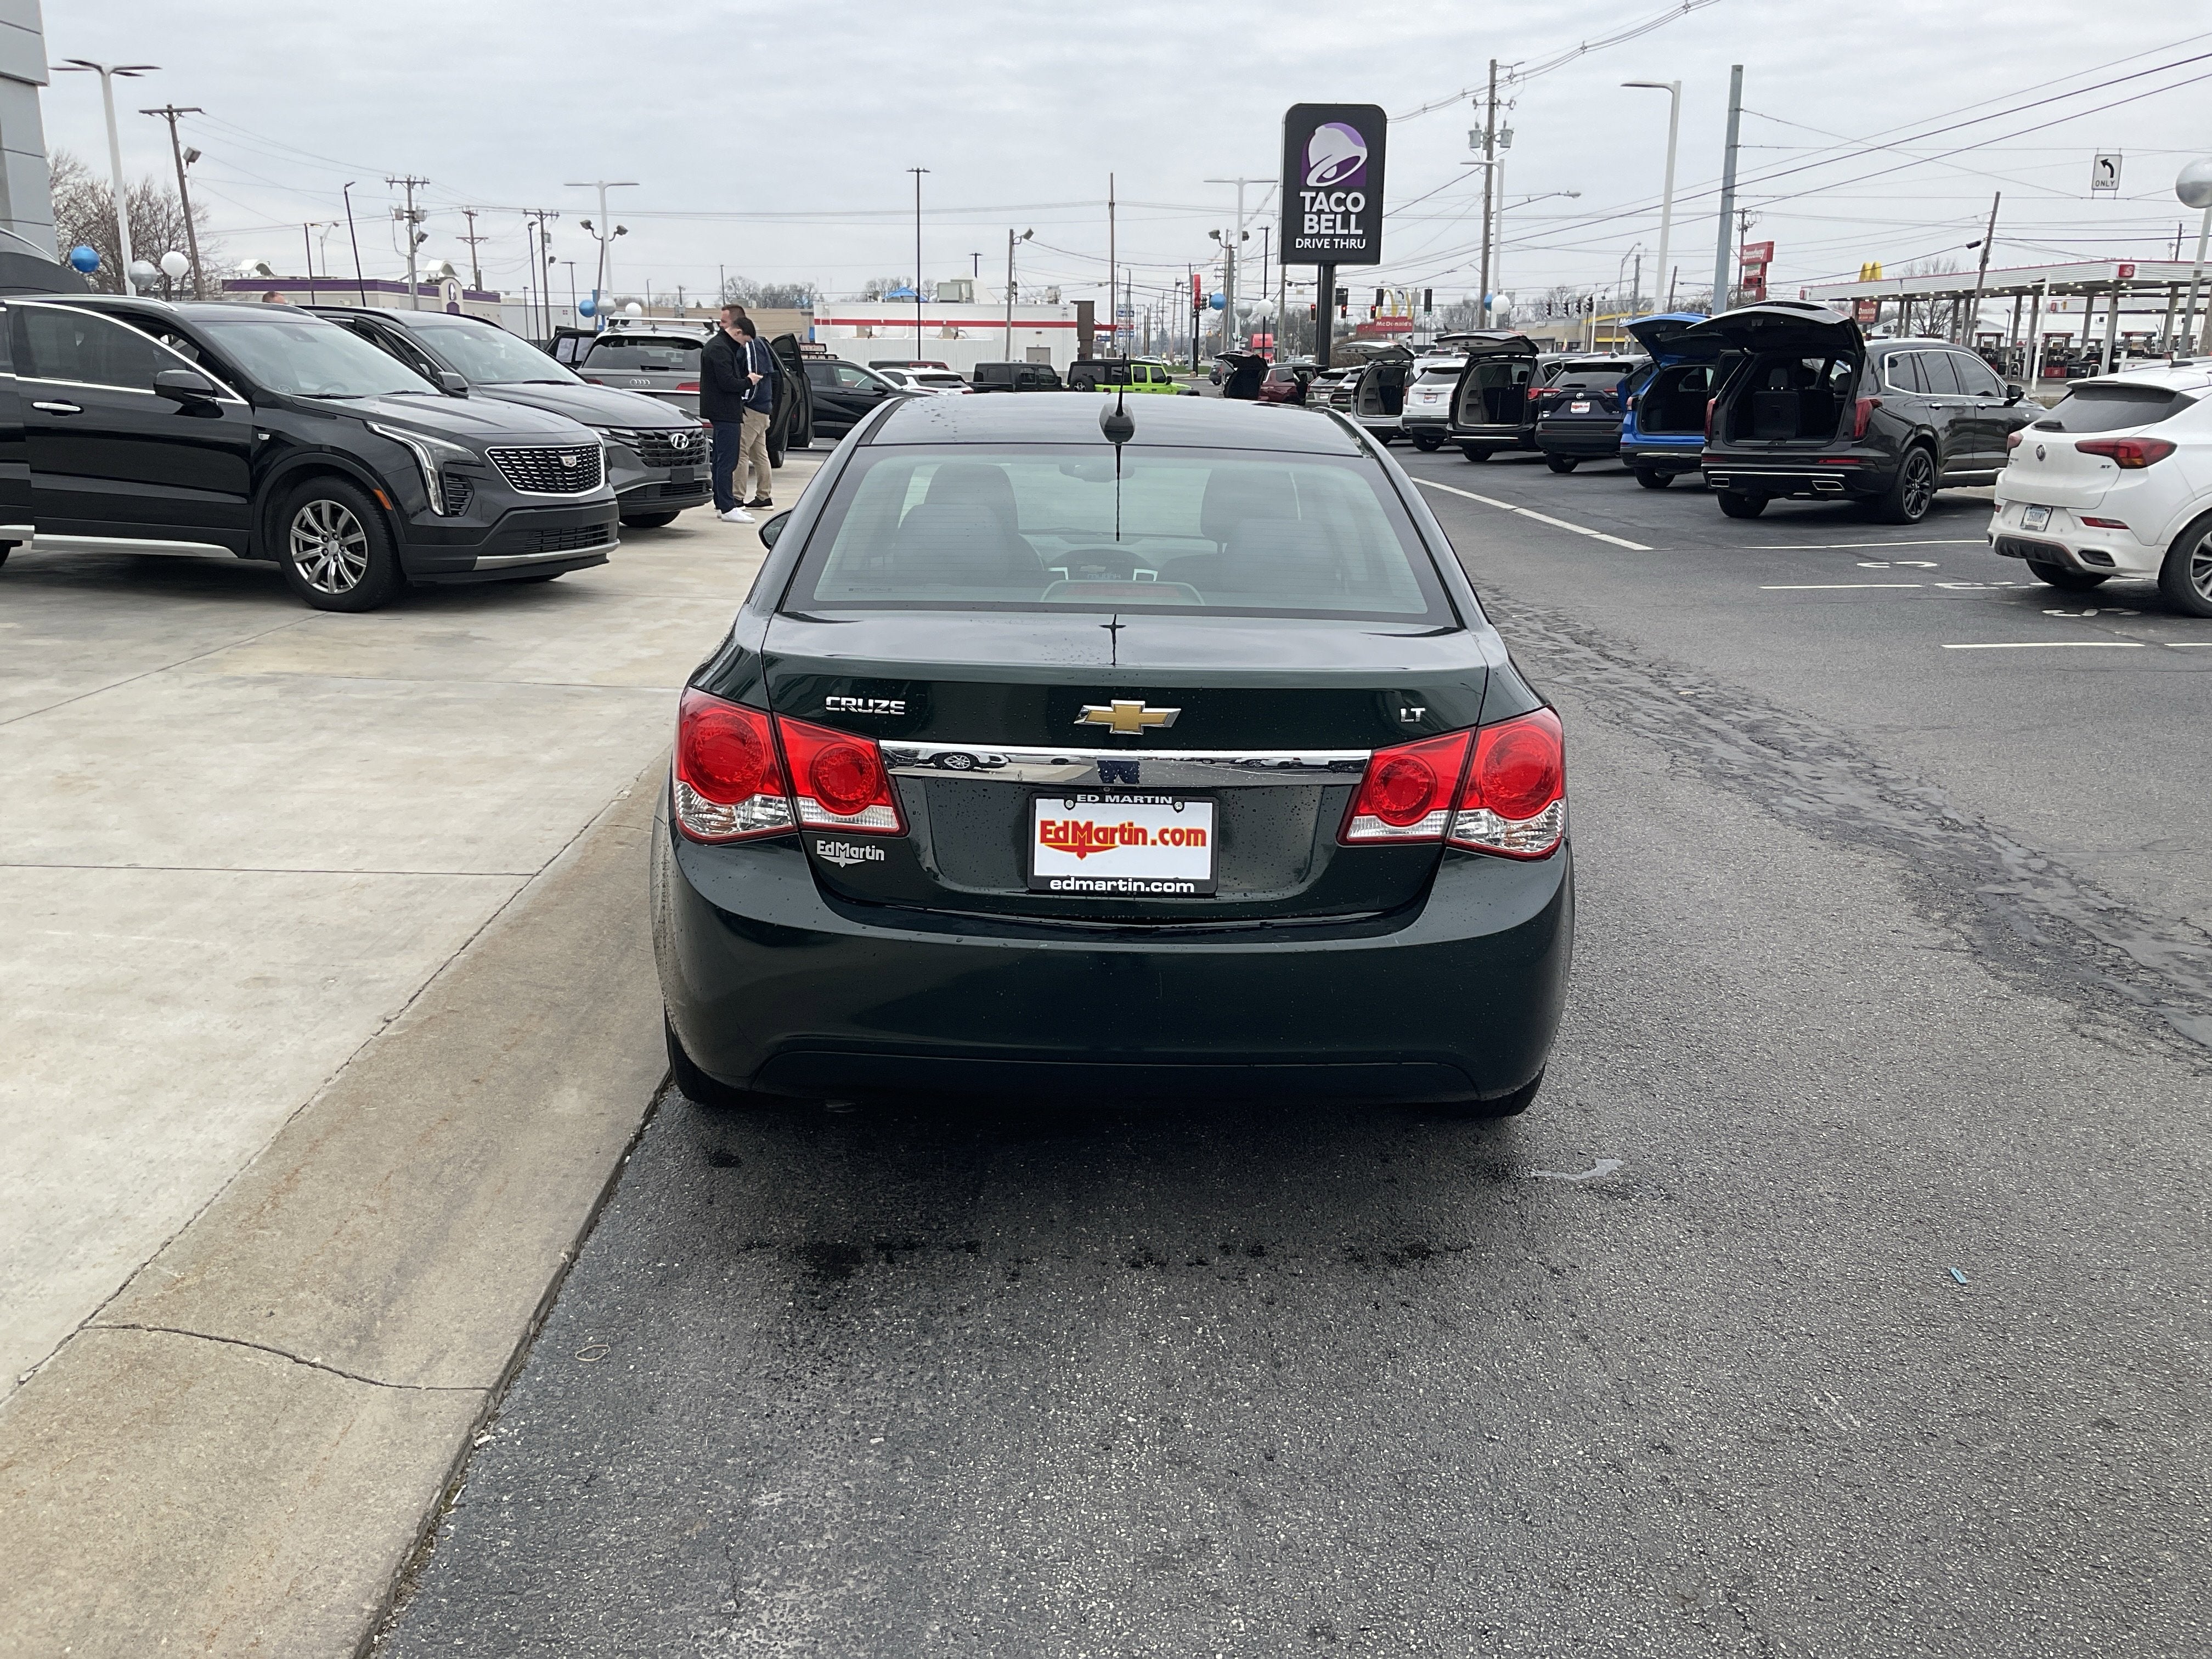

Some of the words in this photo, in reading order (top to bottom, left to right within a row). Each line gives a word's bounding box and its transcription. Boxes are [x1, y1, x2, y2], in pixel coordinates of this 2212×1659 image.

[1300, 191, 1365, 213] TACO
[1304, 214, 1363, 235] BELL
[1295, 238, 1330, 249] DRIVE
[1333, 239, 1366, 250] THRU
[825, 696, 906, 715] CRUZE
[1400, 707, 1425, 723] LT
[1076, 794, 1099, 802] ED
[1105, 795, 1172, 804] MARTIN
[1039, 819, 1206, 850] EdMartin.com
[816, 840, 884, 864] EdMartin
[1049, 877, 1194, 893] edmartin.com
